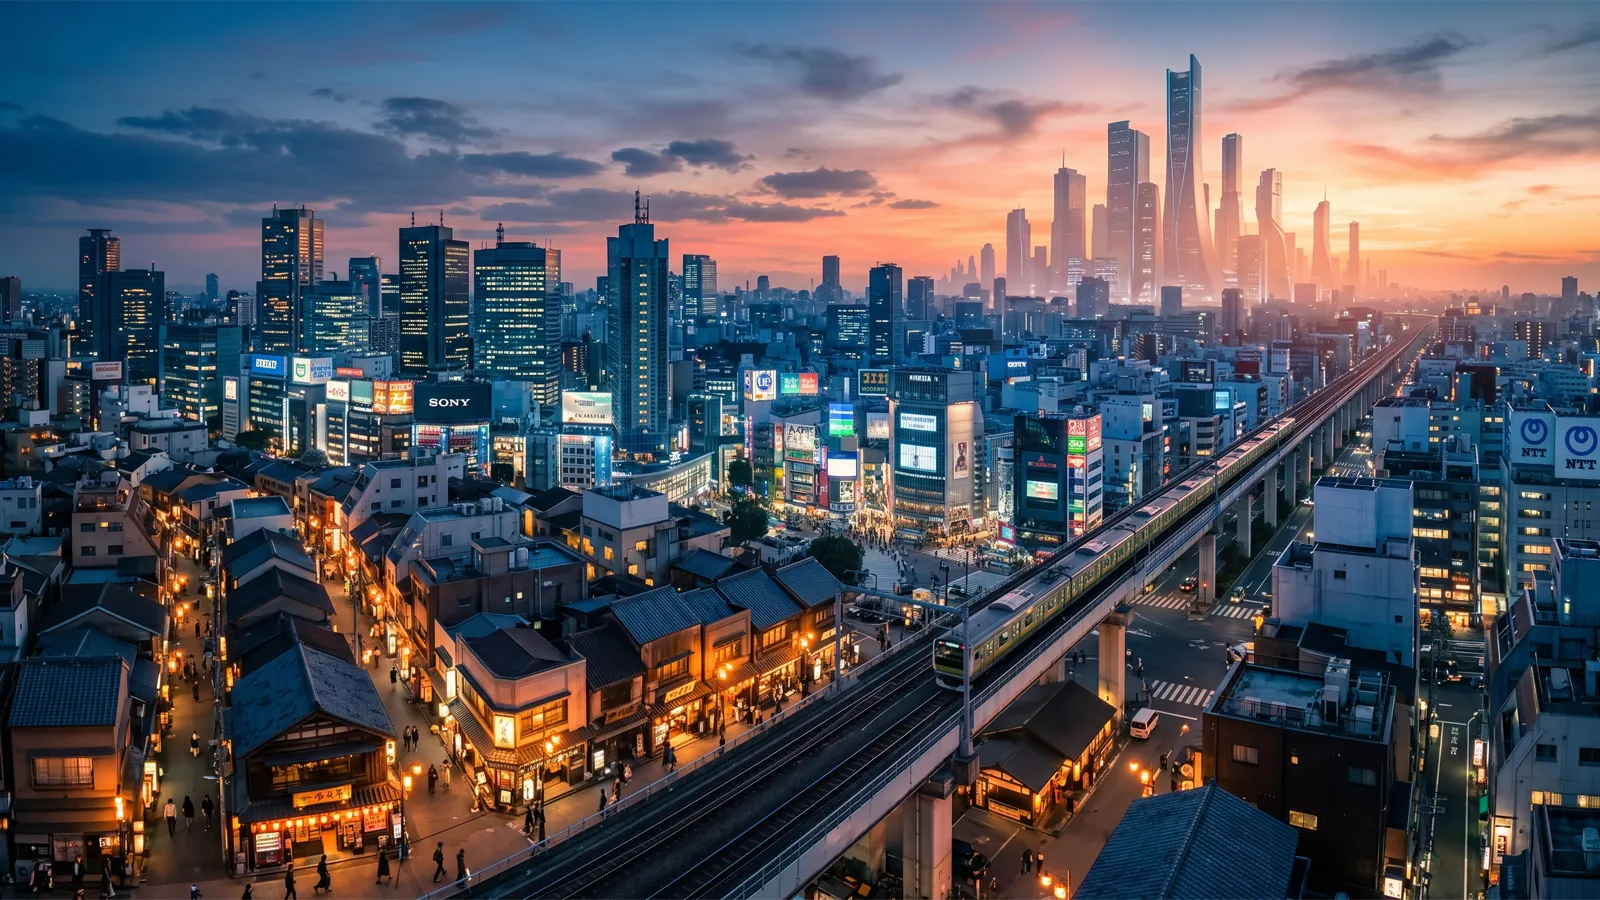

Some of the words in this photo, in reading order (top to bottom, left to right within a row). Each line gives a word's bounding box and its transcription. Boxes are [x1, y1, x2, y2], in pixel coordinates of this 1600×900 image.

[429, 398, 470, 407] SONY
[1521, 447, 1547, 458] NTT
[1565, 458, 1597, 470] NTT
